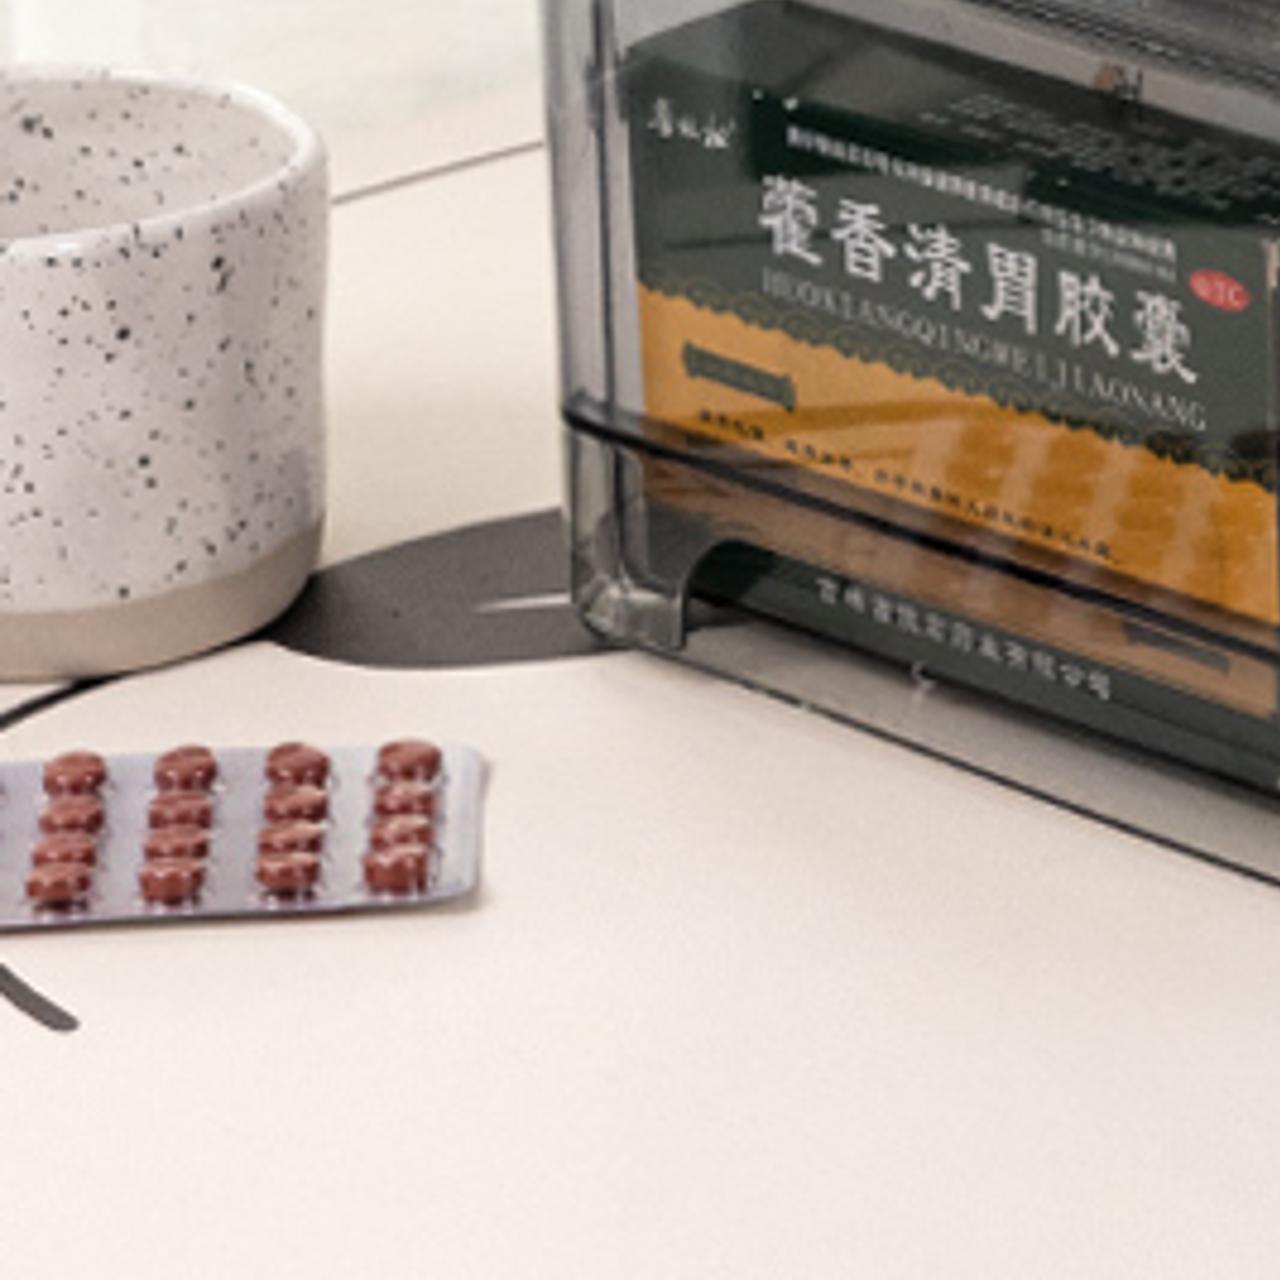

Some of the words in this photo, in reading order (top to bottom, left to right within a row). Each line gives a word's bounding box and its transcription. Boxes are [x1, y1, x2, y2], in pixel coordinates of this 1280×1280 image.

[757, 172, 1199, 385] 藿香清胃胶囊
